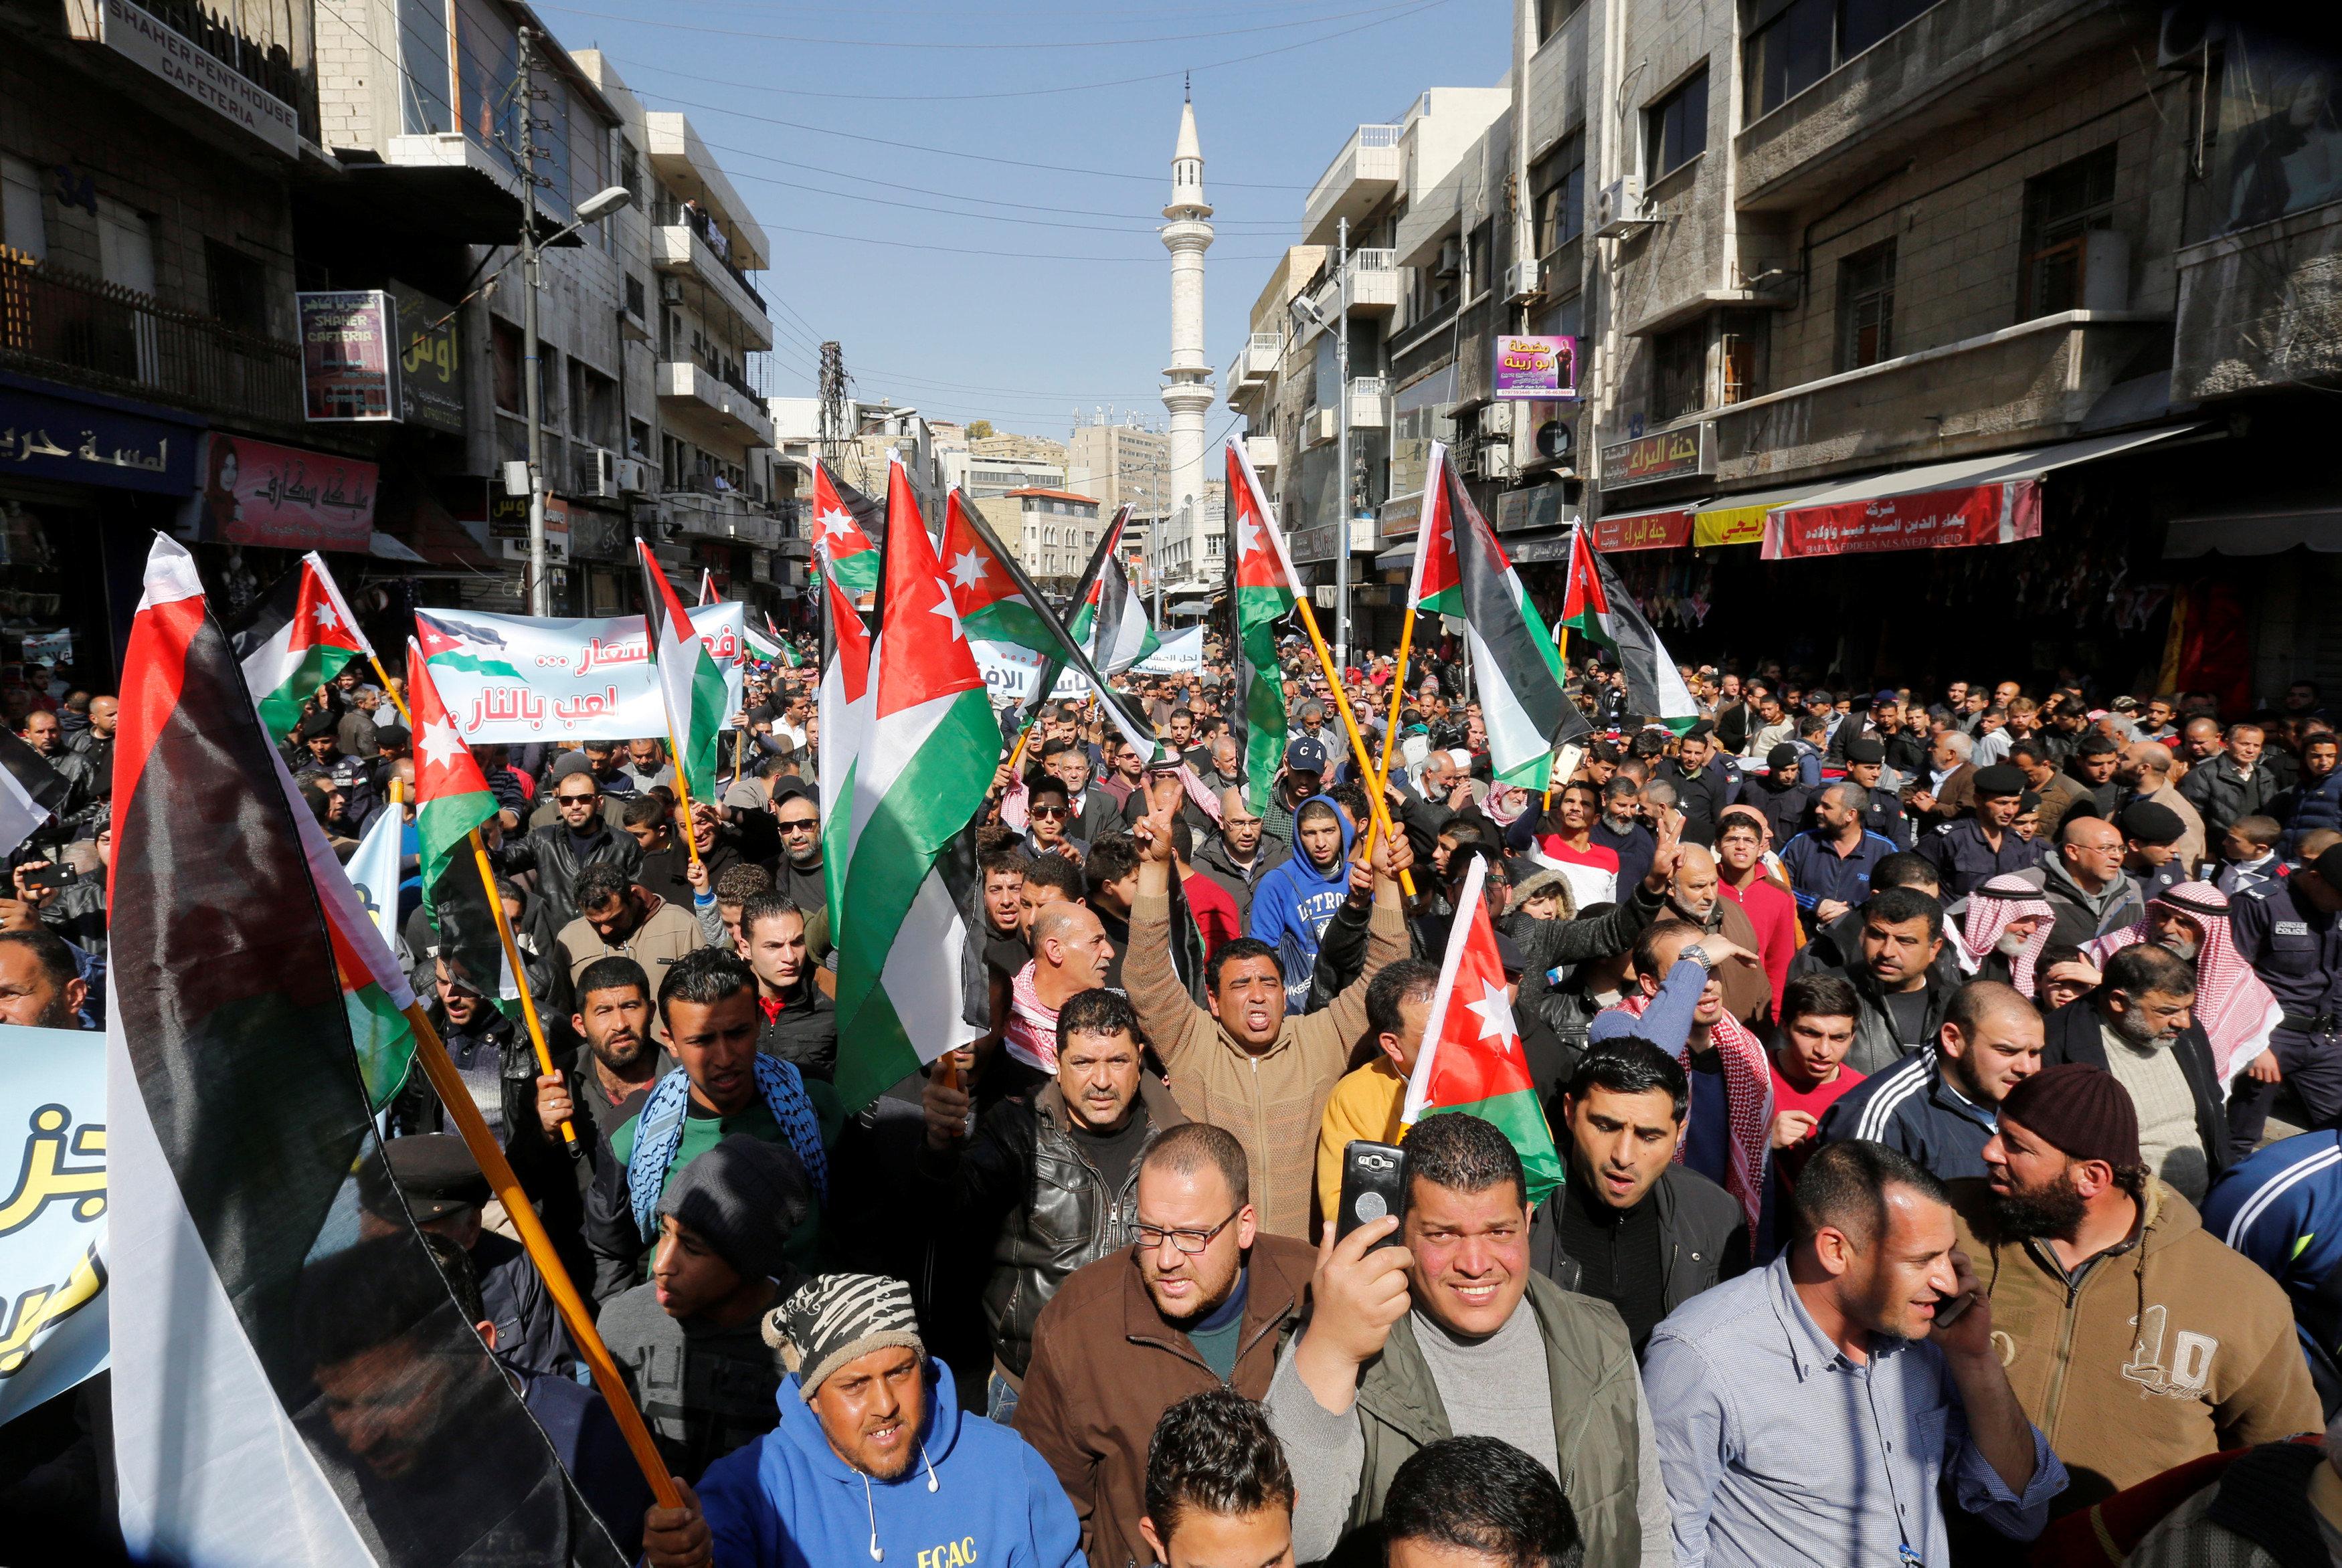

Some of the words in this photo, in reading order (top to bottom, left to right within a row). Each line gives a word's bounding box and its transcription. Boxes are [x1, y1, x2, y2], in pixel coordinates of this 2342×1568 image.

[109, 1, 191, 66] SHAHER
[162, 57, 255, 128] CAFETERIA
[314, 314, 367, 326] SHAHER
[307, 330, 373, 342] CAFTERIA
[0, 426, 74, 462] حري
[78, 429, 167, 473] لمسة
[1866, 501, 1895, 518] شركة
[1941, 514, 1965, 528] بهاء
[1624, 518, 1647, 547] البراء
[1649, 518, 1667, 545] جنة
[1869, 518, 1901, 535] السيد
[1905, 515, 1936, 534] الدين
[1881, 536, 1927, 549] ALSAYED
[574, 637, 650, 678] سعار
[465, 686, 546, 734] بالنار
[552, 685, 620, 730] لعب
